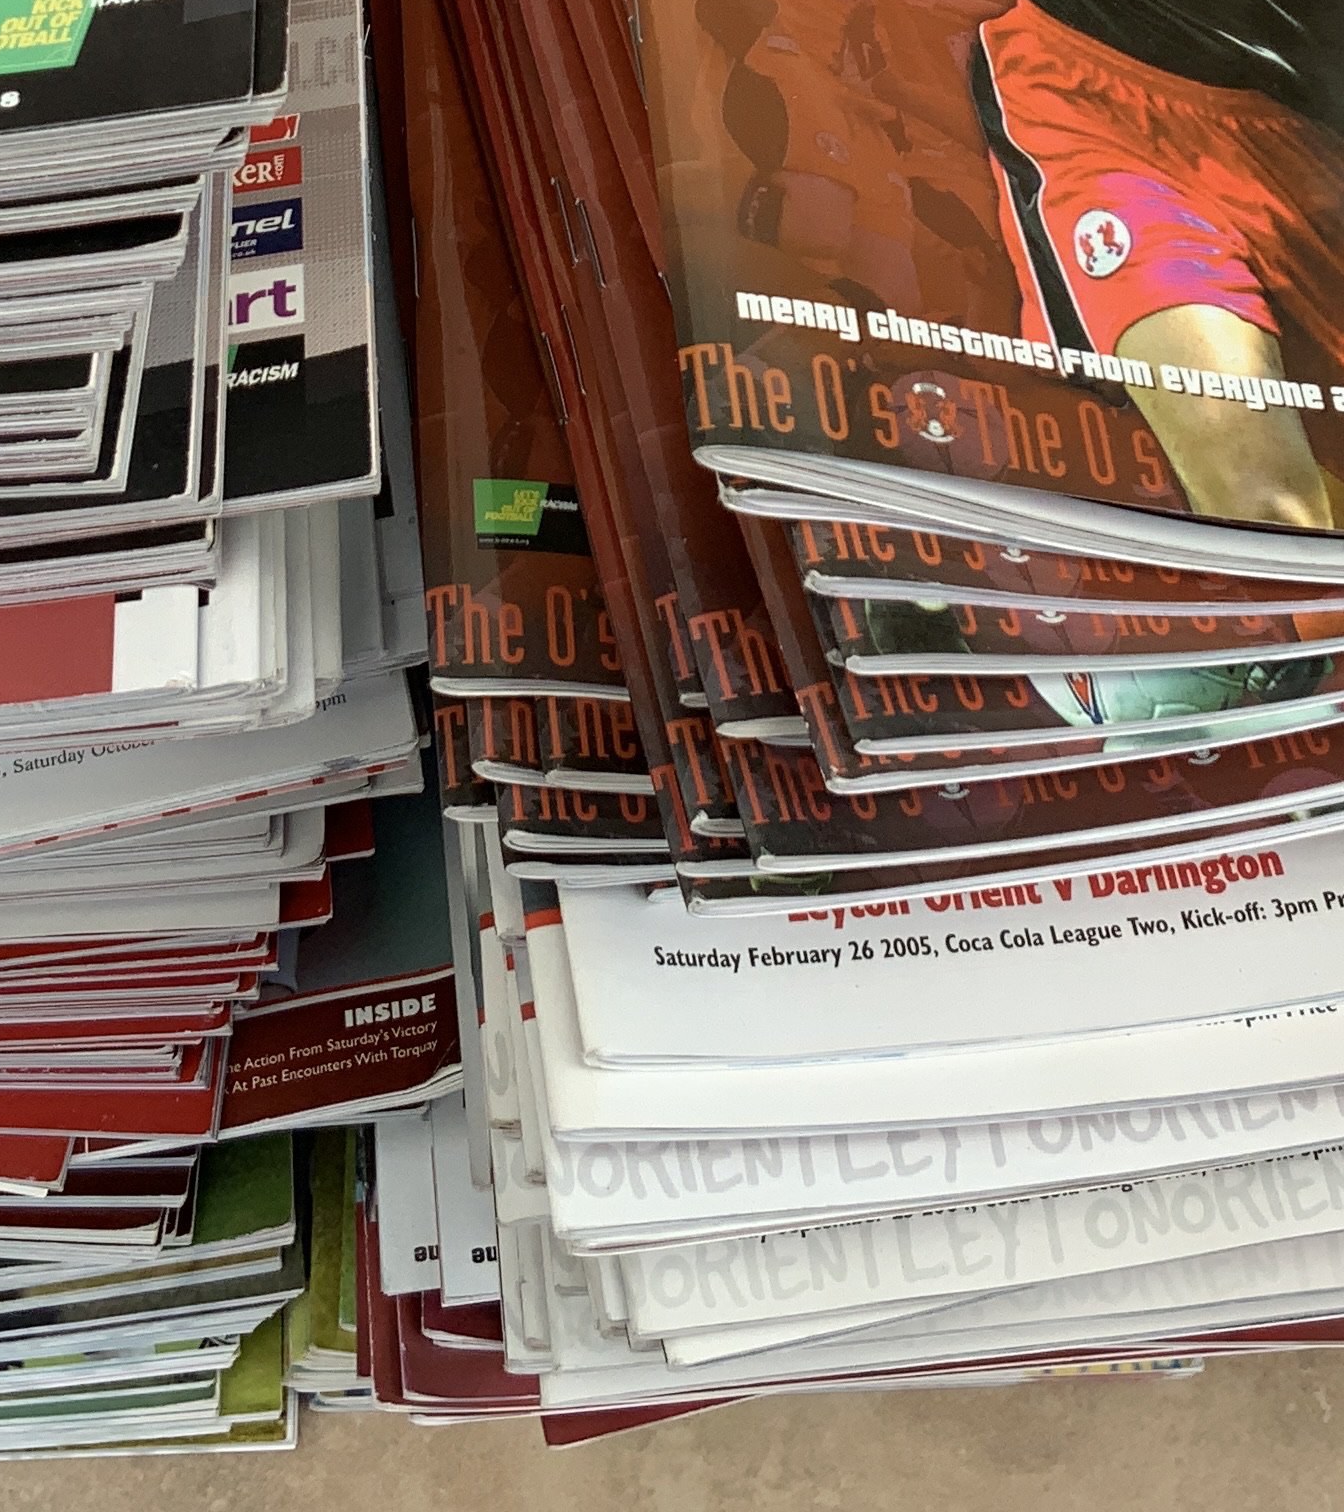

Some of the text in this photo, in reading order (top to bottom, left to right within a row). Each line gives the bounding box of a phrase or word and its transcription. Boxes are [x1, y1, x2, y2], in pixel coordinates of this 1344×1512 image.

[1, 12, 81, 35] OUT OF
[11, 747, 87, 776] Saturday
[653, 945, 742, 974] Saturday
[747, 944, 843, 969] February
[849, 938, 874, 962] 26
[882, 935, 940, 959] 2005,
[945, 932, 994, 955] Coca
[999, 927, 1045, 950] Cola
[1049, 921, 1123, 947] League
[1126, 914, 1176, 939] Two,
[1180, 900, 1269, 932] Kick-off:
[1271, 893, 1318, 927] 3pm
[343, 993, 437, 1029] INSIDE
[232, 1079, 249, 1095] At
[251, 1073, 279, 1090] Past
[281, 1057, 353, 1083] Encounters
[354, 1049, 389, 1067] With
[390, 1038, 439, 1061] Torquay
[242, 1019, 439, 1072] Action From Saturday's Victory
